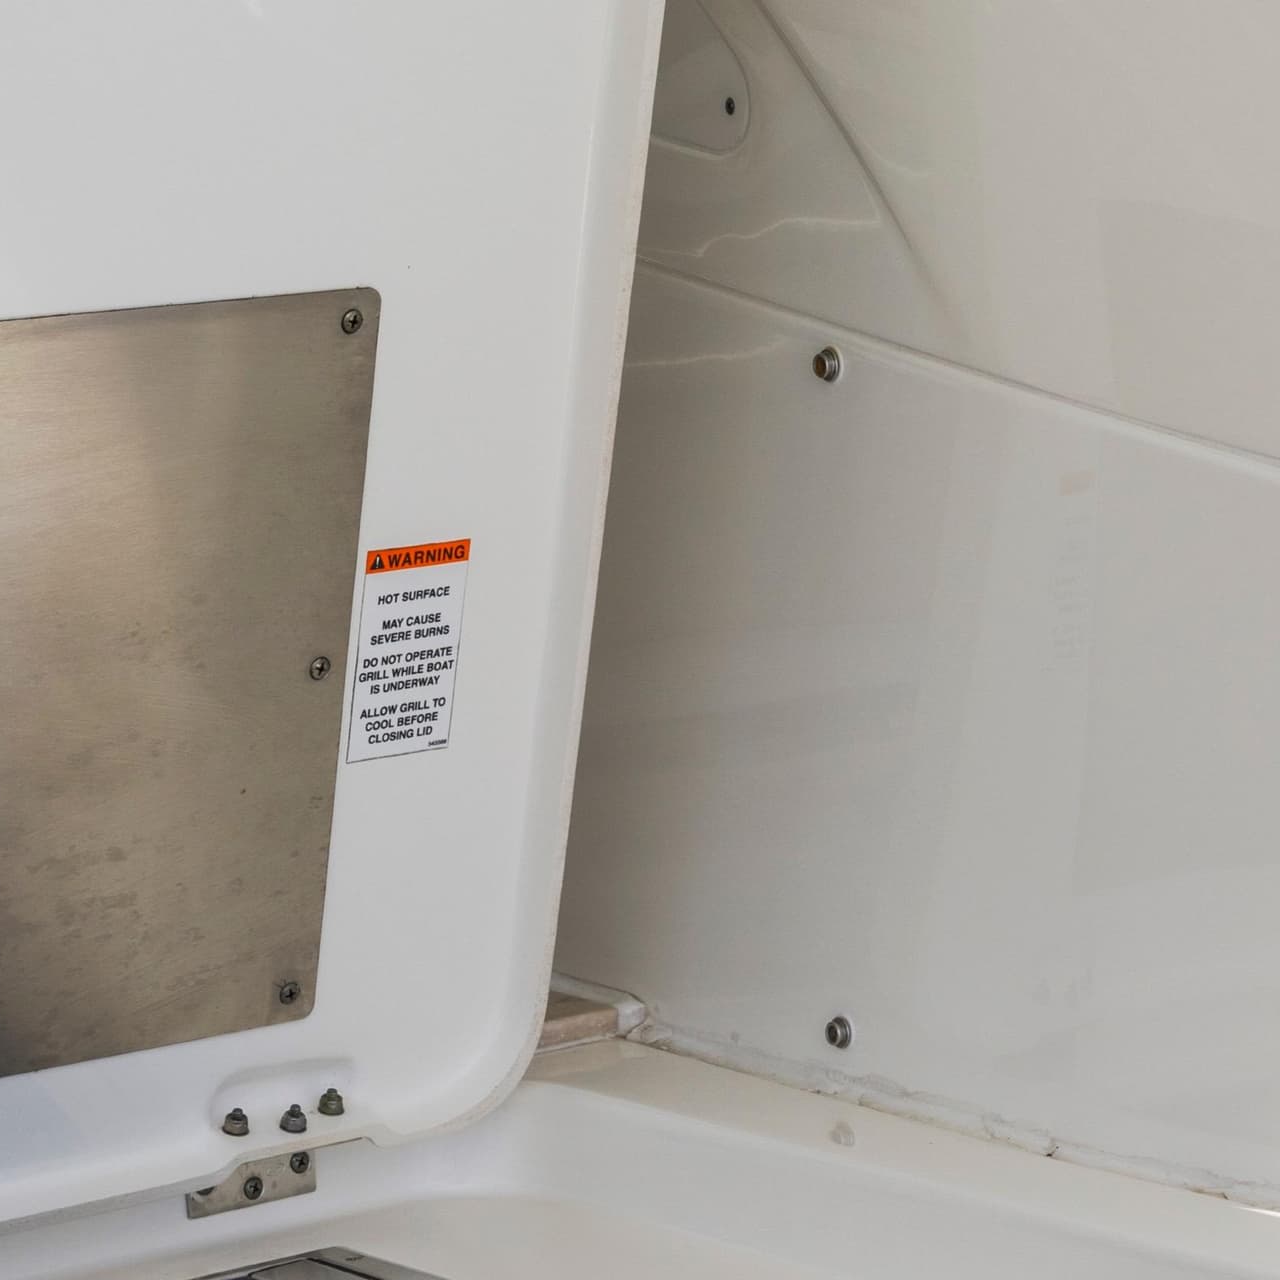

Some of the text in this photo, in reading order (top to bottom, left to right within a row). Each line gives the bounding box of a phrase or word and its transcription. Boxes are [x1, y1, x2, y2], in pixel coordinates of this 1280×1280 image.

[387, 544, 465, 569] WARNING
[377, 586, 450, 606] HOT SURFACE
[382, 612, 442, 630] MAY CAUSE
[370, 625, 450, 646] SEVERE BURNS
[363, 646, 453, 669] DO NOT OPERATE
[358, 659, 454, 683] GRILL WHILE BOAT
[370, 675, 440, 695] IS UNDERWAY
[360, 697, 446, 720] ALLOW GRILL TO
[365, 711, 438, 732] COOL BEFORE
[368, 729, 414, 744] CLOSING
[416, 726, 433, 737] LID
